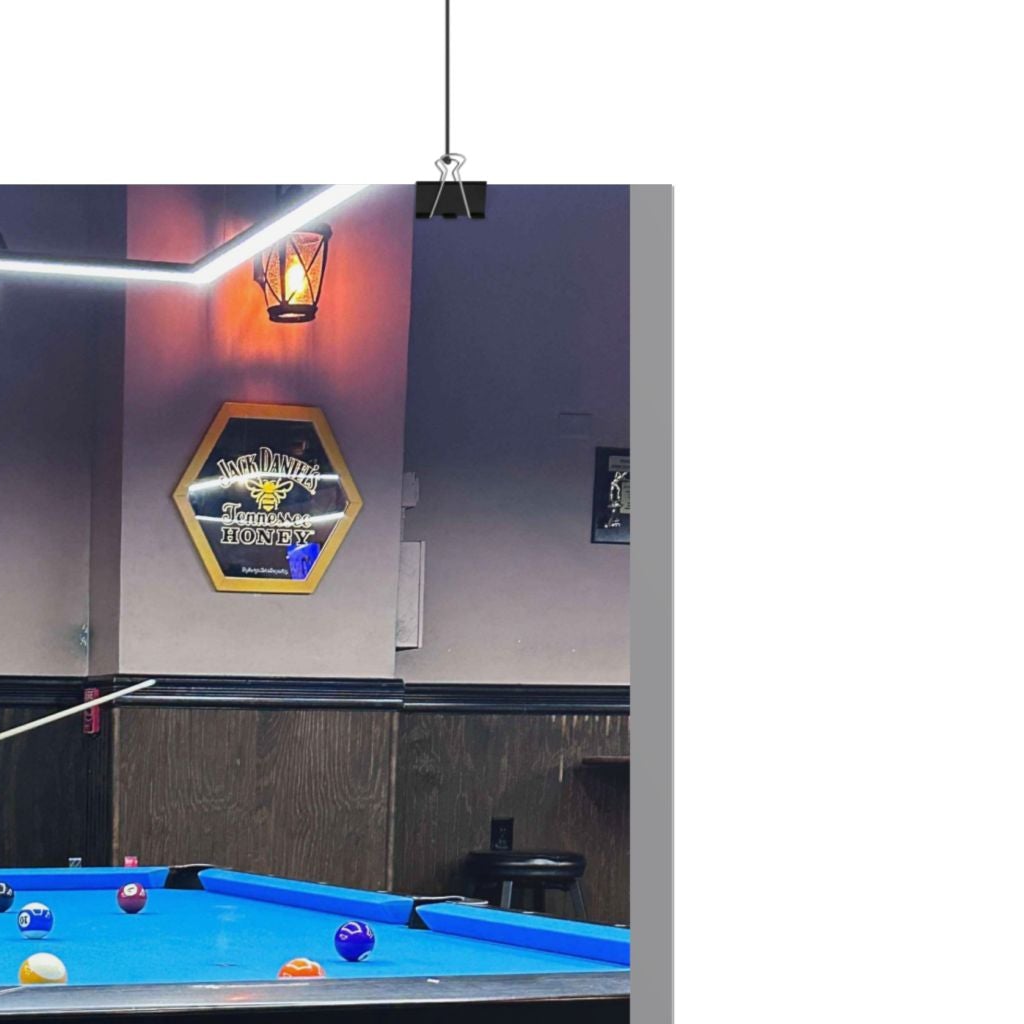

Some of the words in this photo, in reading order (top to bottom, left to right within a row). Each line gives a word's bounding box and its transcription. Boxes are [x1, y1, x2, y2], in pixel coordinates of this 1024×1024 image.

[217, 454, 257, 488] JACK
[259, 447, 321, 495] DANIEL'S
[221, 502, 312, 528] Tennessee
[220, 527, 315, 546] HONEY
